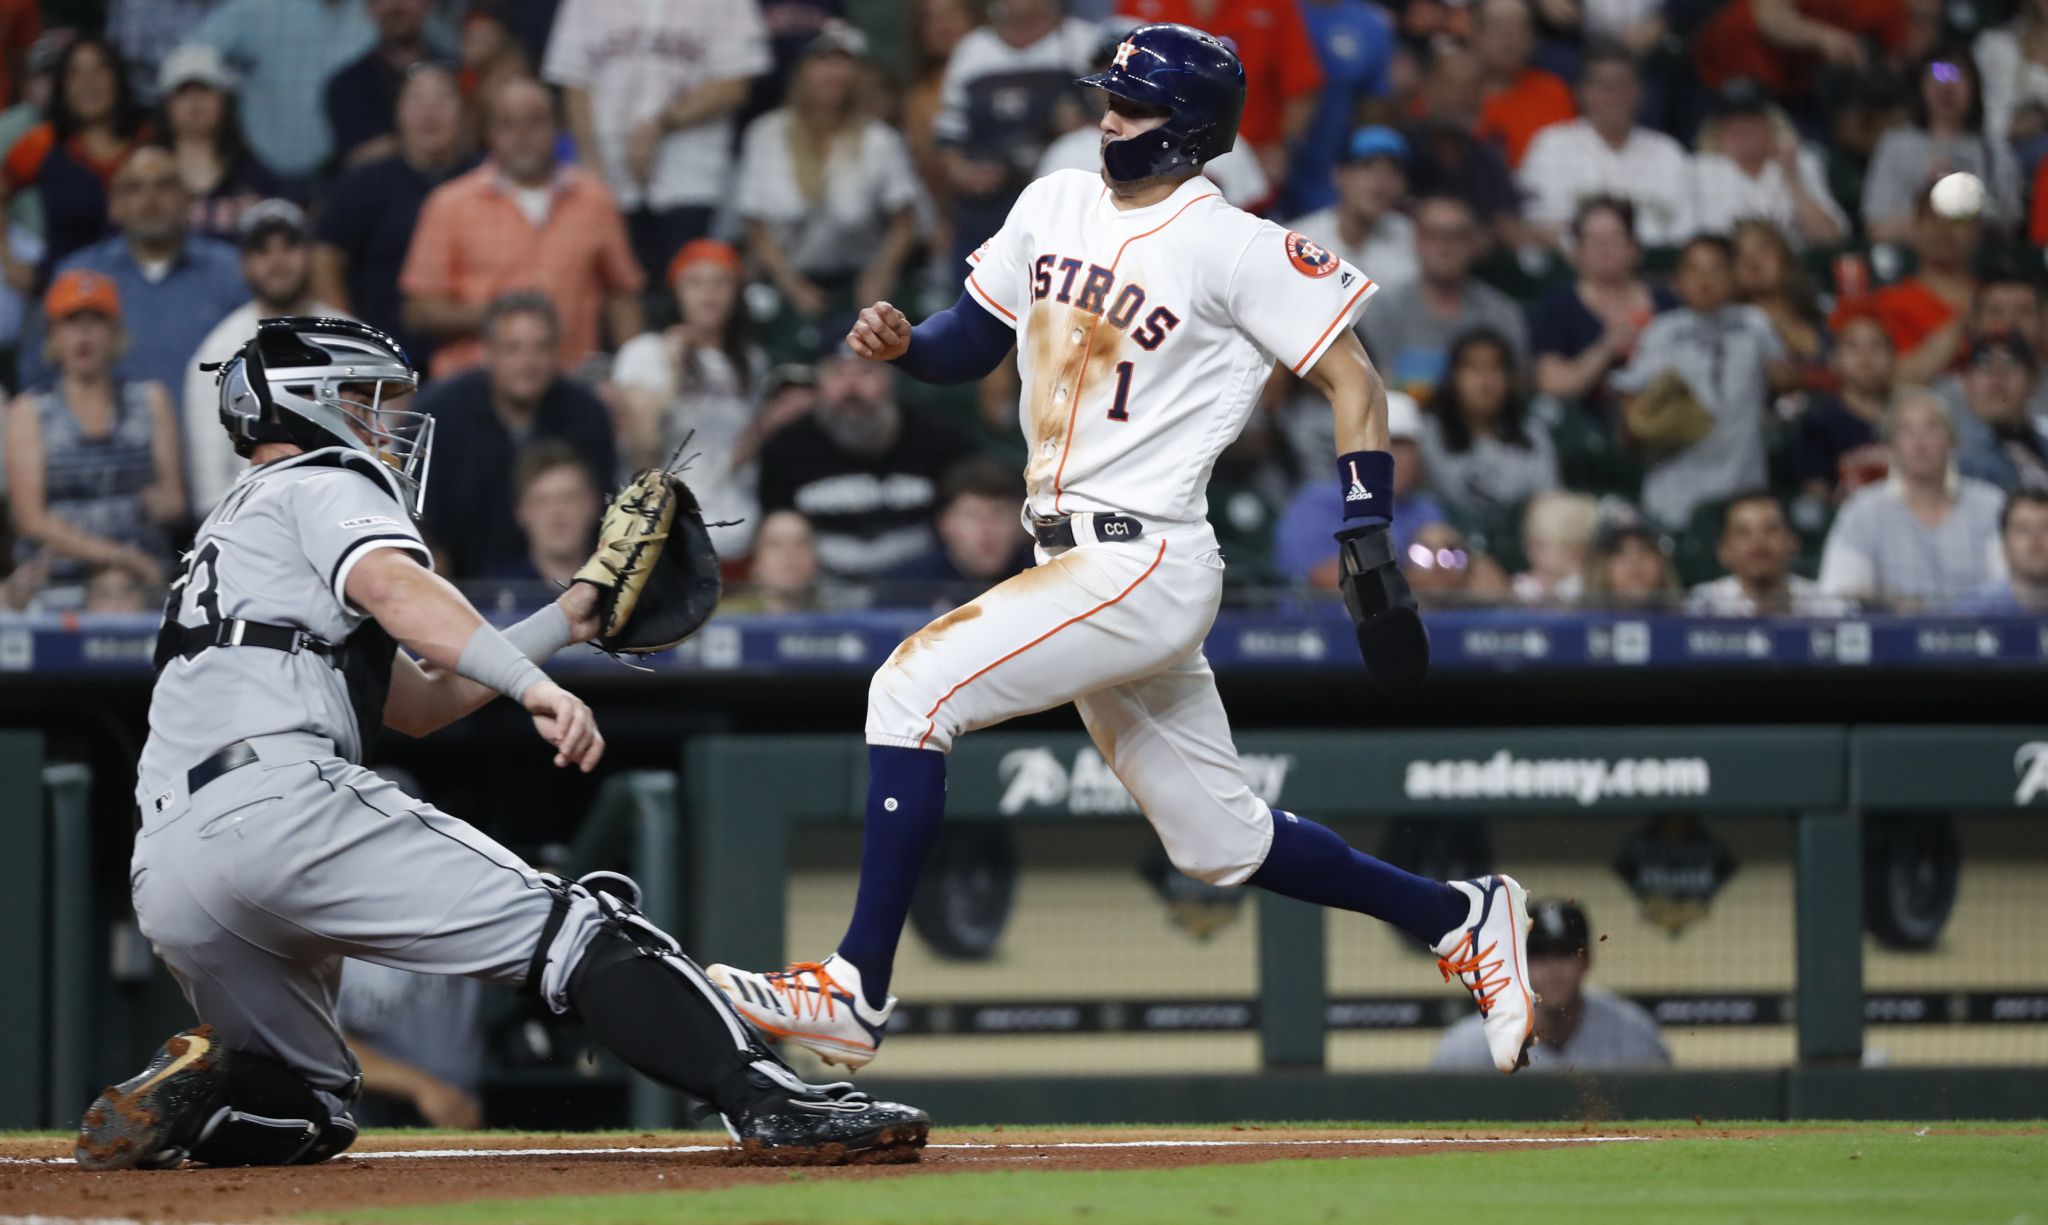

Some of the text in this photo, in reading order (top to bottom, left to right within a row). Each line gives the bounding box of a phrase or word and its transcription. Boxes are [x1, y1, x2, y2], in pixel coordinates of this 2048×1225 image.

[1027, 253, 1182, 352] STROS
[1106, 360, 1135, 423] 1
[1345, 492, 1373, 502] adidas
[1104, 521, 1130, 536] CC1
[1404, 749, 1711, 806] academy.com
